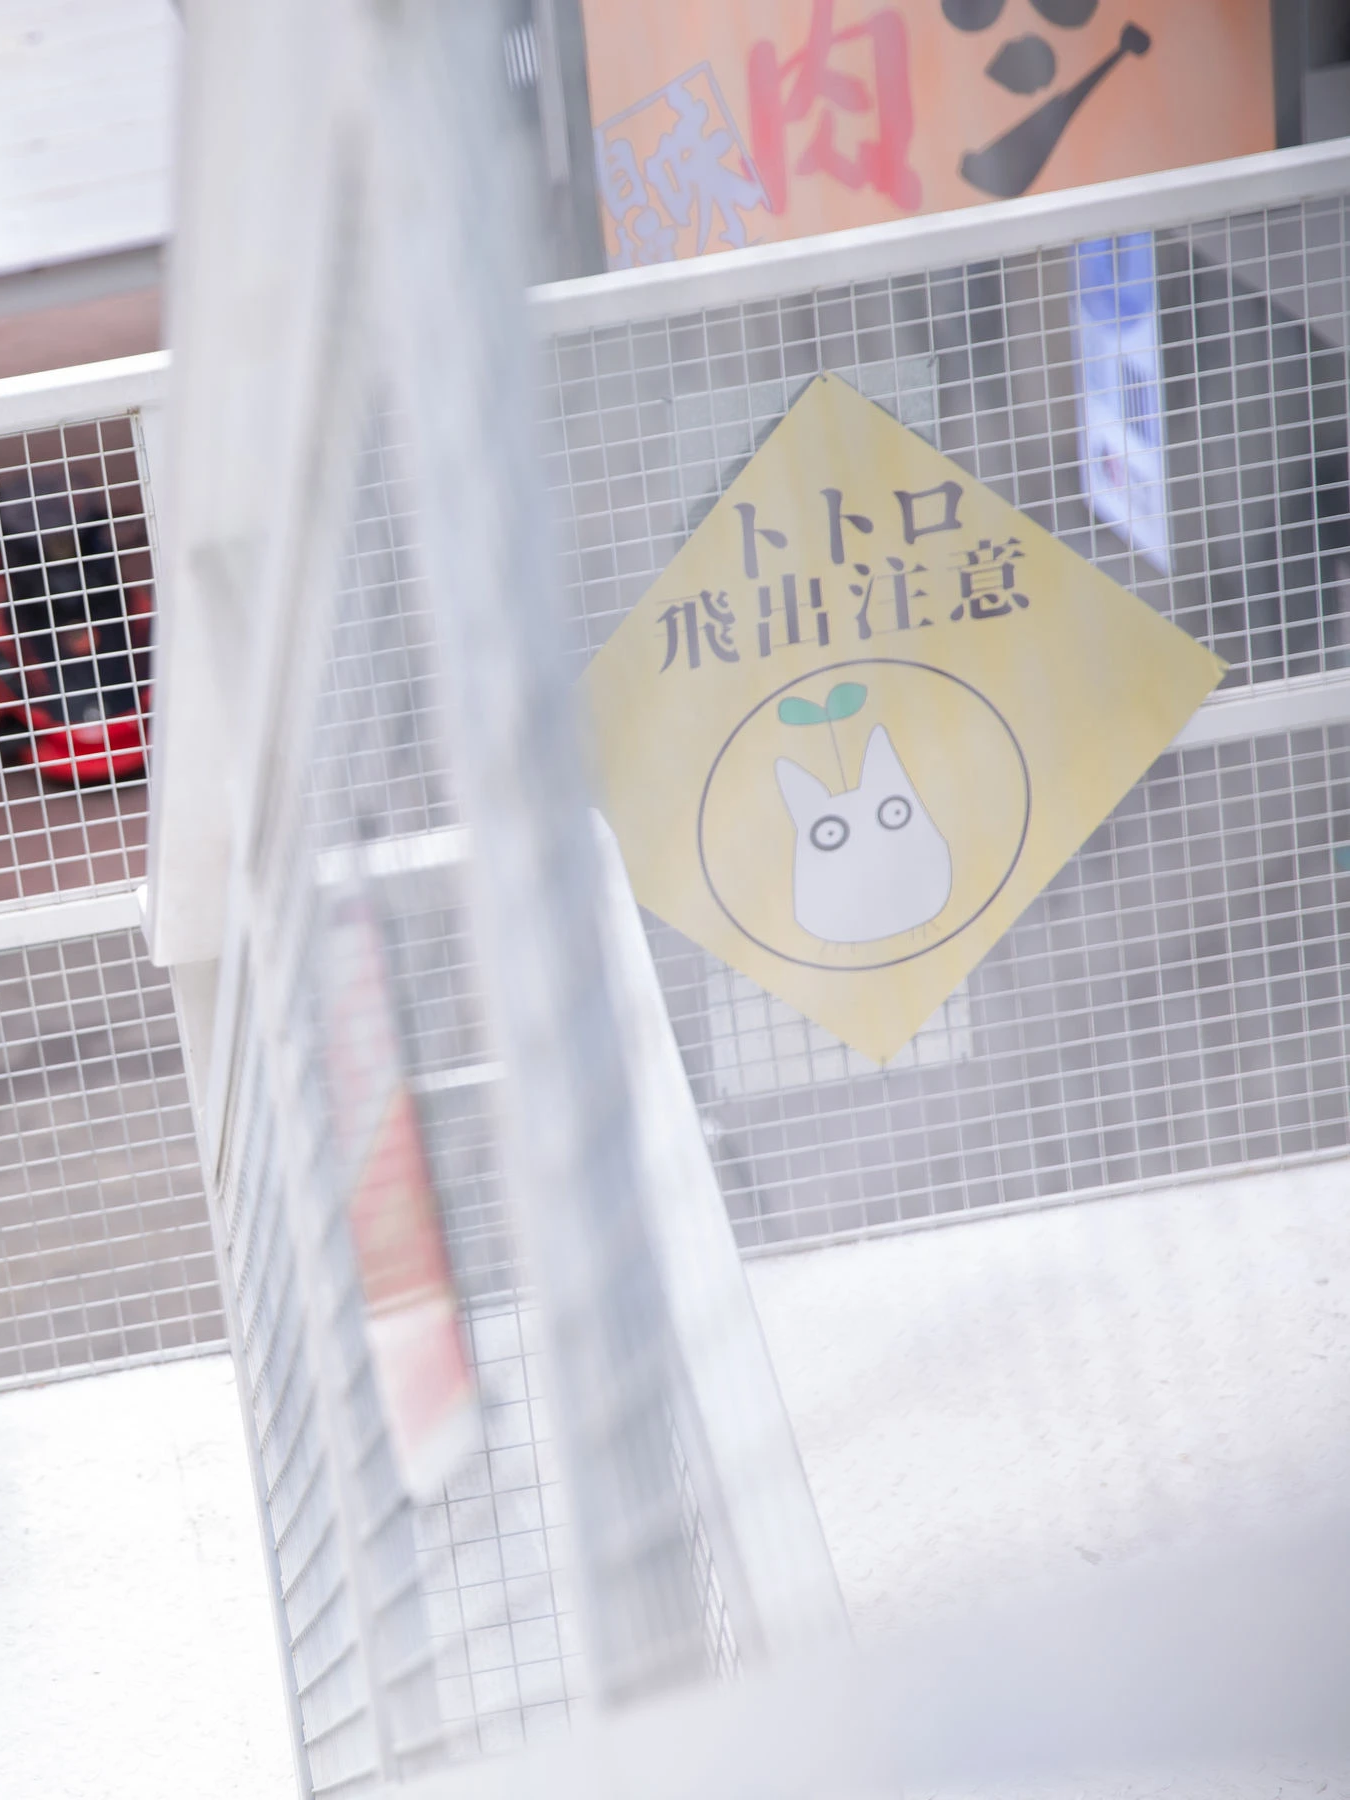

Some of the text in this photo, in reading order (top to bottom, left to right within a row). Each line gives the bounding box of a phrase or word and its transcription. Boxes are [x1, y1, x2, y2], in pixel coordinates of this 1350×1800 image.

[733, 480, 965, 580] トトロ
[653, 536, 1031, 675] 飛出注意
